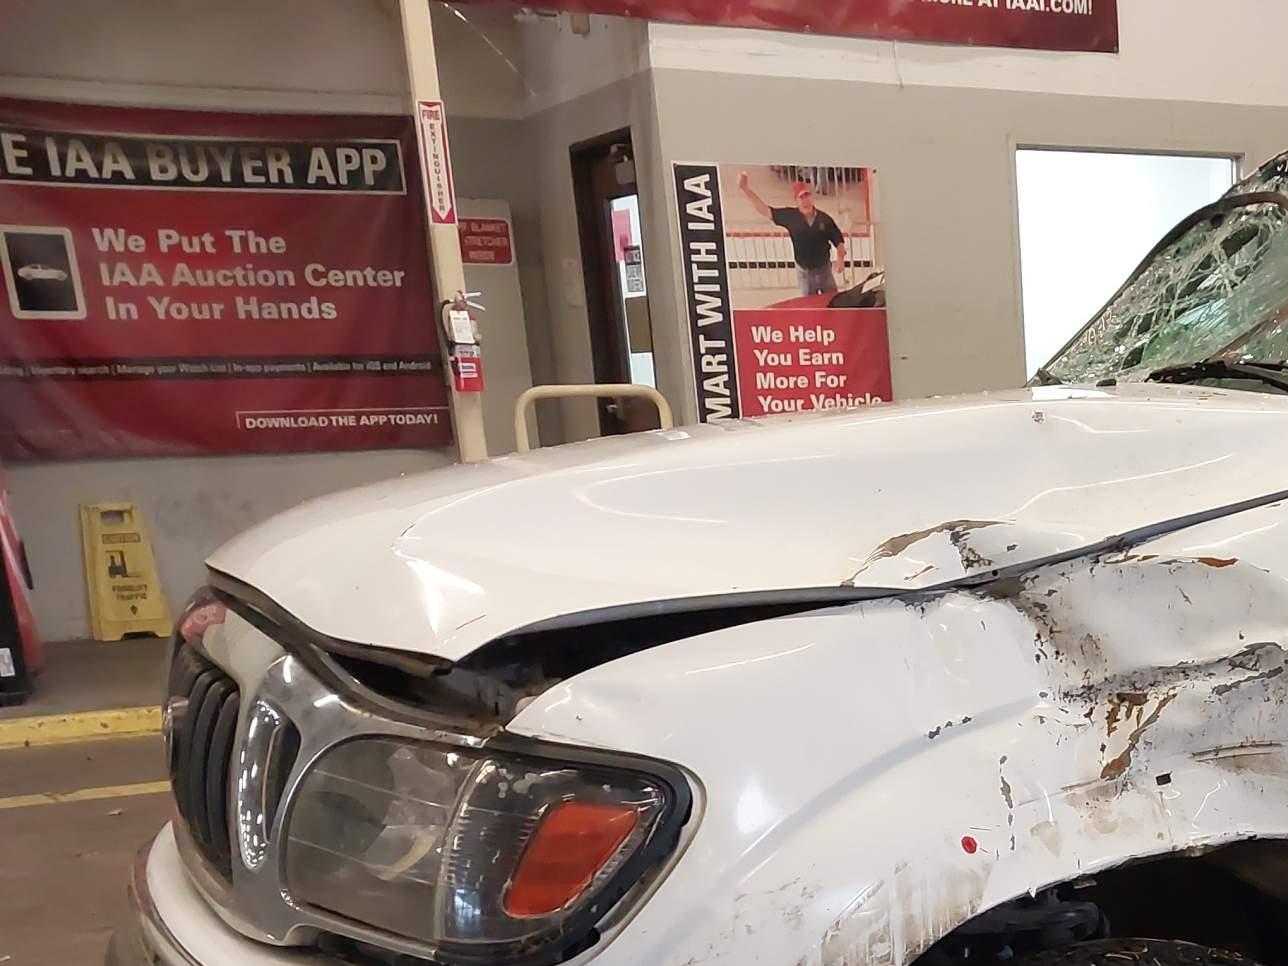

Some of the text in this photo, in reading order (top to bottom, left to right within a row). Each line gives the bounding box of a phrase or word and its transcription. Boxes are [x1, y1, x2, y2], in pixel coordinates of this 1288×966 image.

[421, 109, 441, 121] FIRE
[44, 136, 136, 180] IAA
[145, 143, 295, 185] BUYER
[306, 147, 387, 186] APP
[428, 123, 446, 212] EXTINGUISHER
[683, 173, 716, 231] IAA
[91, 227, 288, 254] We Put The
[99, 261, 406, 288] IAA Auction Center
[689, 241, 725, 327] WITH
[105, 296, 338, 321] In Your Hands
[751, 325, 836, 346] We Help
[753, 349, 844, 367] You Earn
[756, 372, 848, 389] More For
[757, 395, 805, 413] Your
[245, 413, 438, 430] DOWNLOAD THE APP TODAY!
